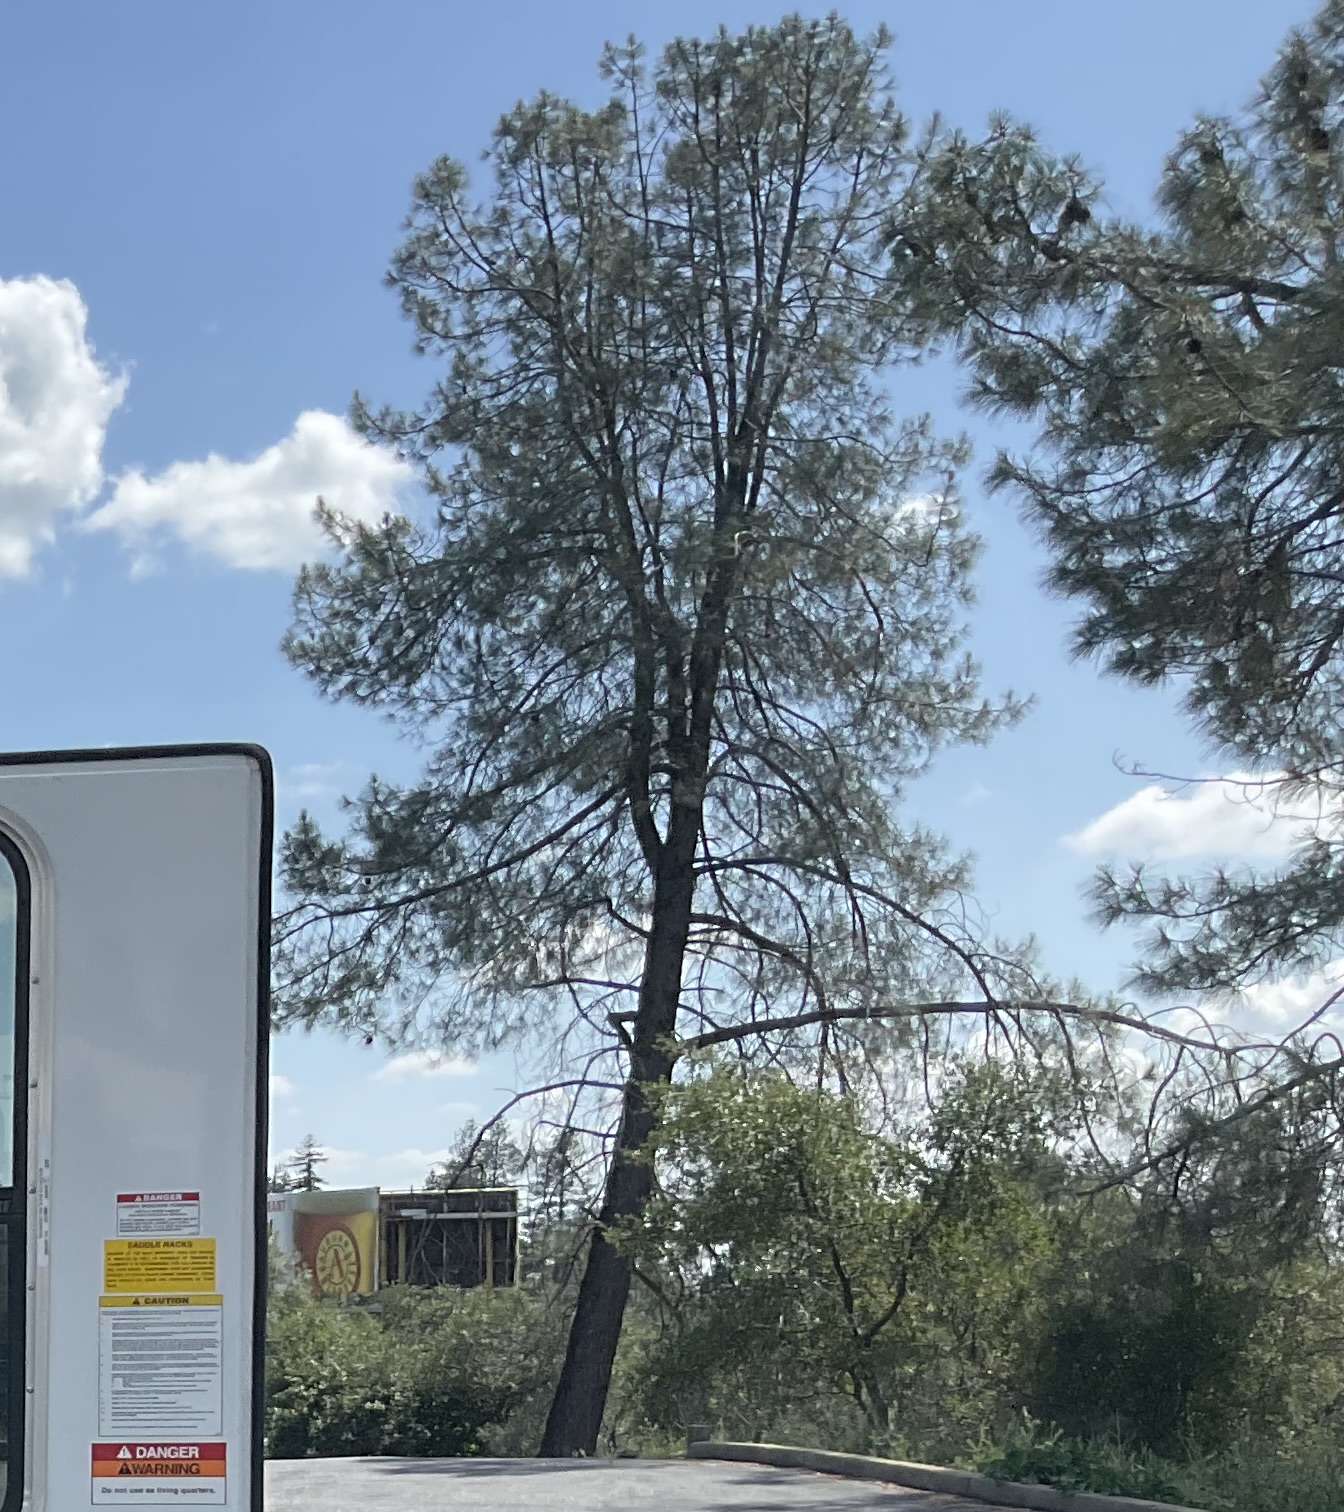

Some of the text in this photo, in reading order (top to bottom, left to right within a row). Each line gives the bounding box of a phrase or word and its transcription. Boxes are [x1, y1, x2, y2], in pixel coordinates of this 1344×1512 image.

[143, 1193, 183, 1201] DANGER
[127, 1240, 193, 1249] SADDLE RACKS
[144, 1297, 189, 1305] CAUTION
[135, 1446, 200, 1459] DANGER
[131, 1463, 200, 1475] WARNING
